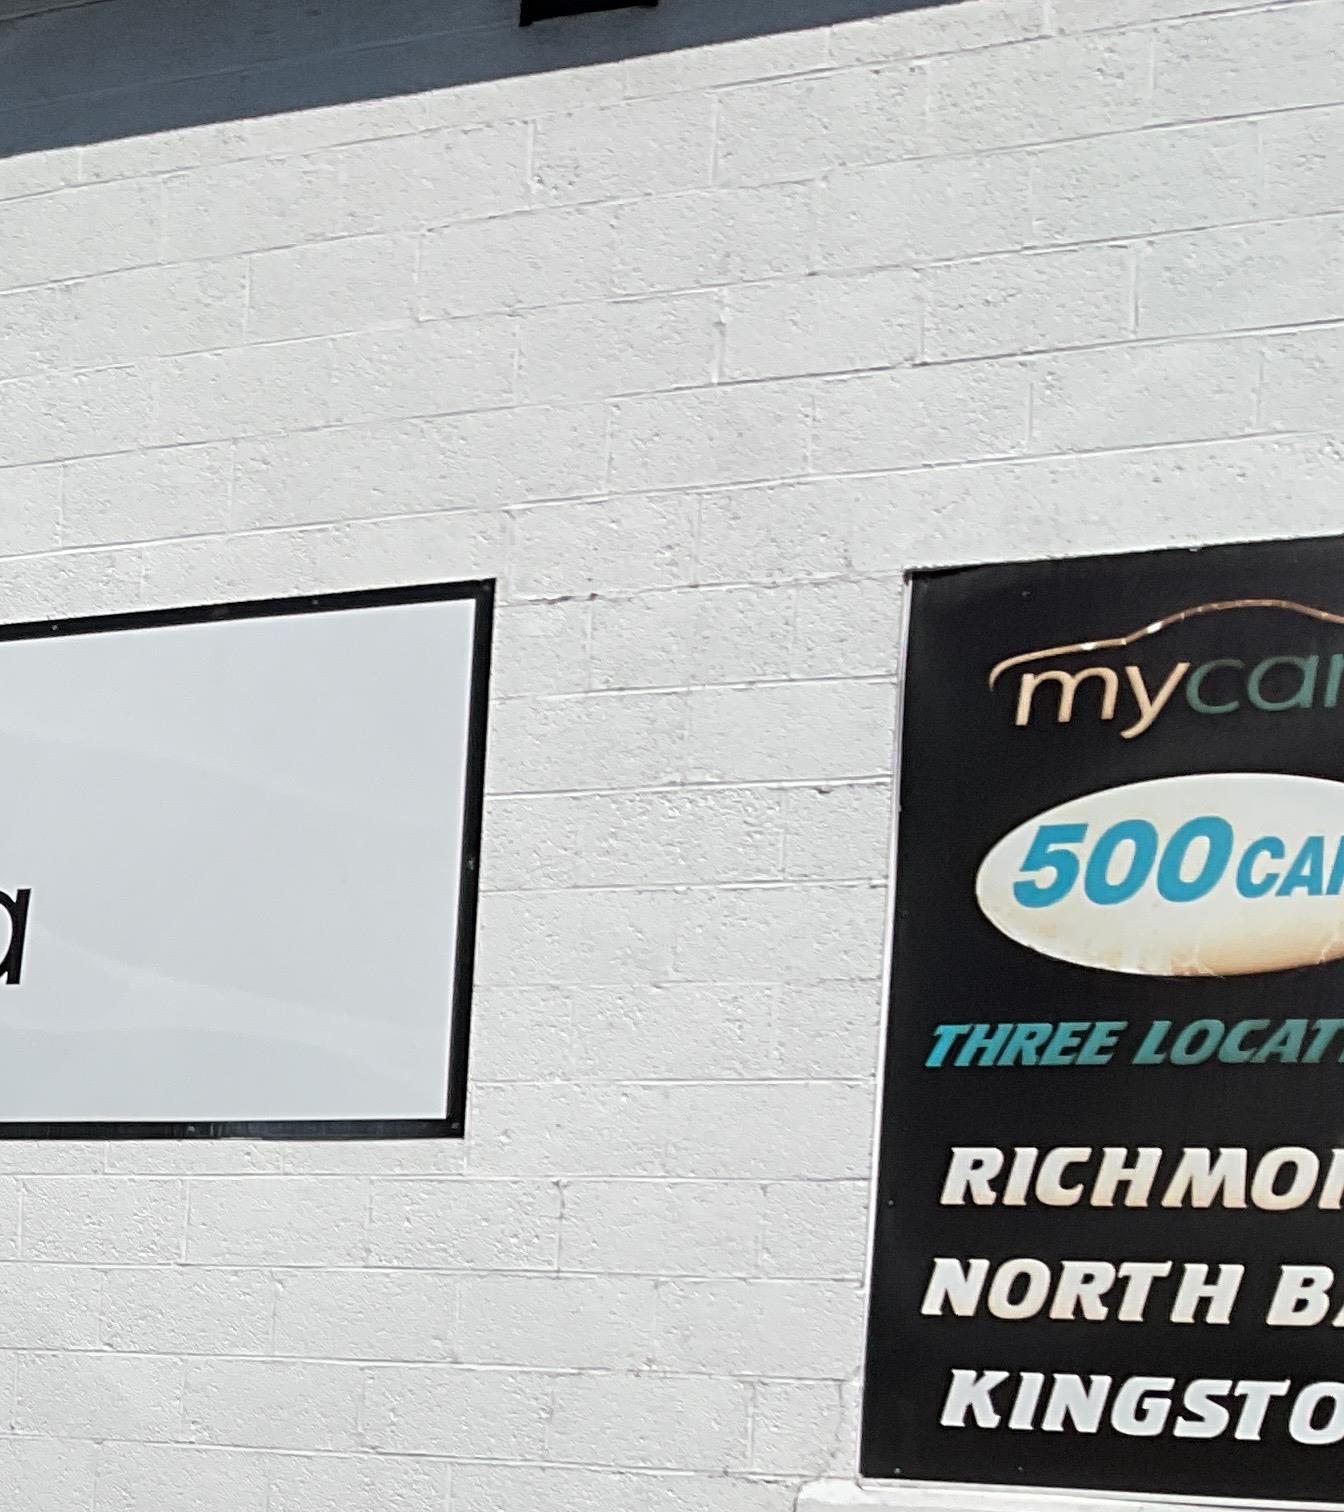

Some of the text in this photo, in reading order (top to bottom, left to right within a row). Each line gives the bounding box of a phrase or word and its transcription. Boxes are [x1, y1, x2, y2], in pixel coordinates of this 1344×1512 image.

[1235, 835, 1344, 899] CA
[925, 1018, 1344, 1067] THREE LOCAT
[920, 1257, 1344, 1328] NORTH B
